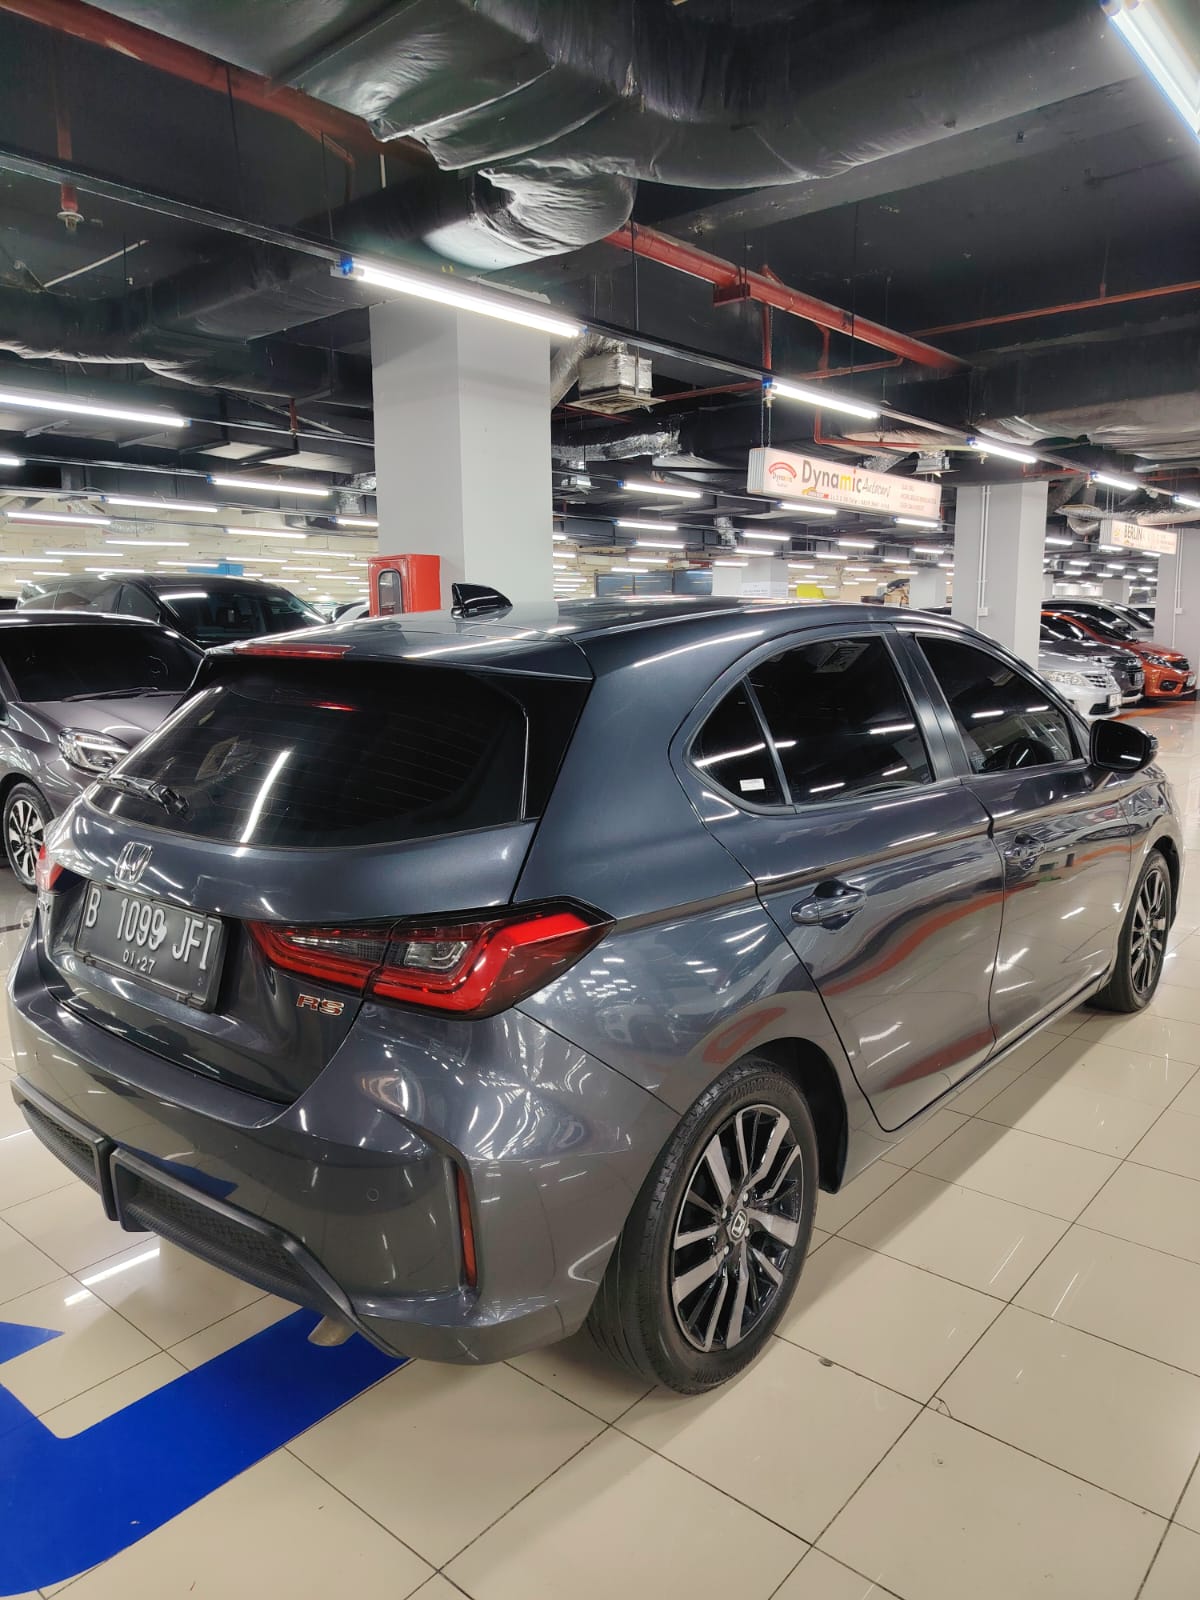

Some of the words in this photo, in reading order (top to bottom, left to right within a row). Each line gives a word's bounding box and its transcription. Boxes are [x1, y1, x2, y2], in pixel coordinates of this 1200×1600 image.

[802, 460, 863, 493] Dynamic
[85, 888, 101, 928] B
[117, 898, 168, 951] 1099
[172, 916, 216, 971] JFI
[296, 993, 345, 1016] RS
